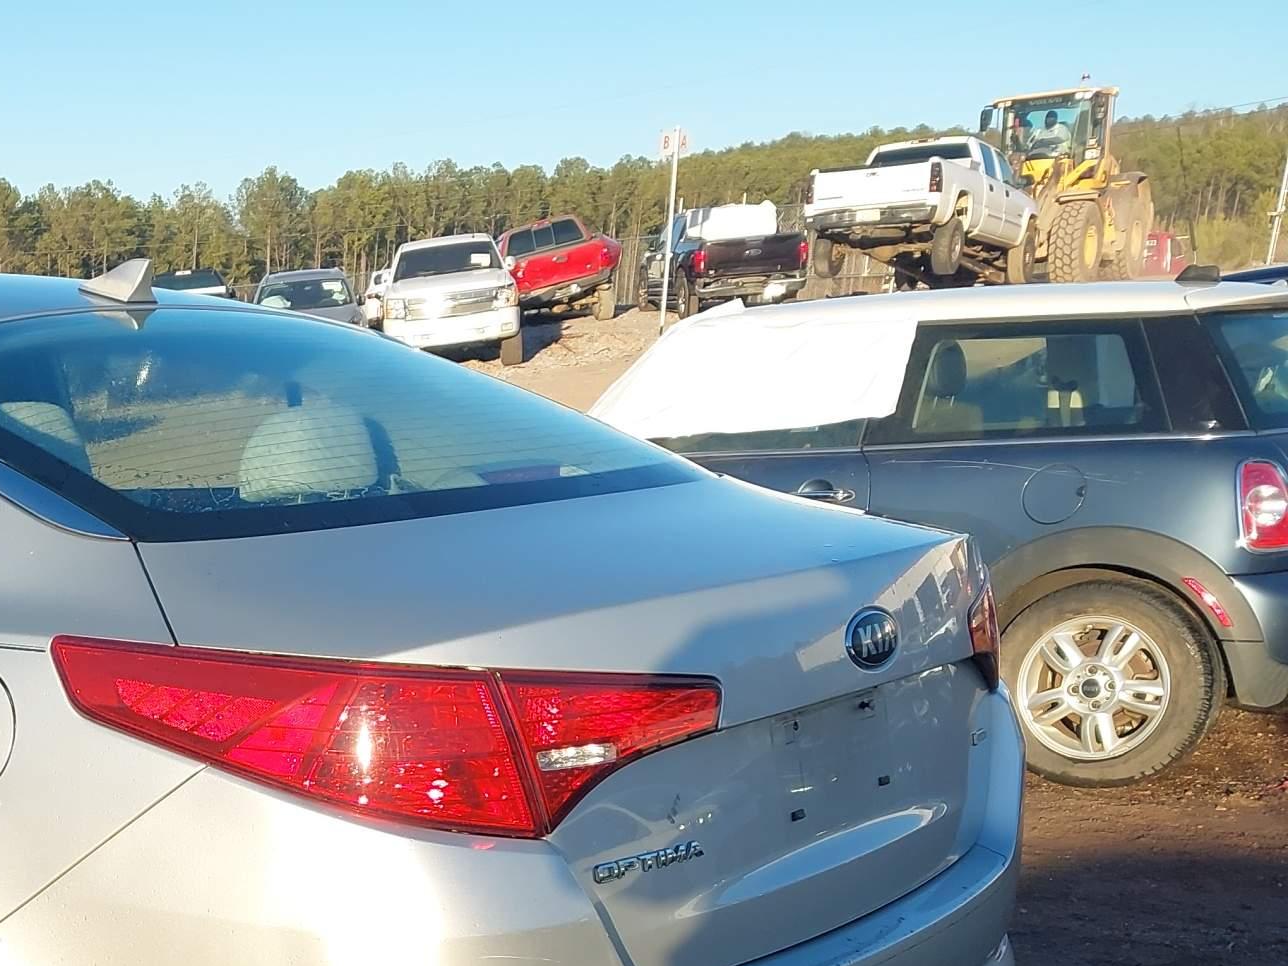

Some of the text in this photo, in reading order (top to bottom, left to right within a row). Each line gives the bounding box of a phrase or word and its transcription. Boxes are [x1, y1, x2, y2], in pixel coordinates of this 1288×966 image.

[663, 135, 670, 150] B
[857, 621, 897, 658] KIA
[592, 840, 704, 885] OPTIMA
